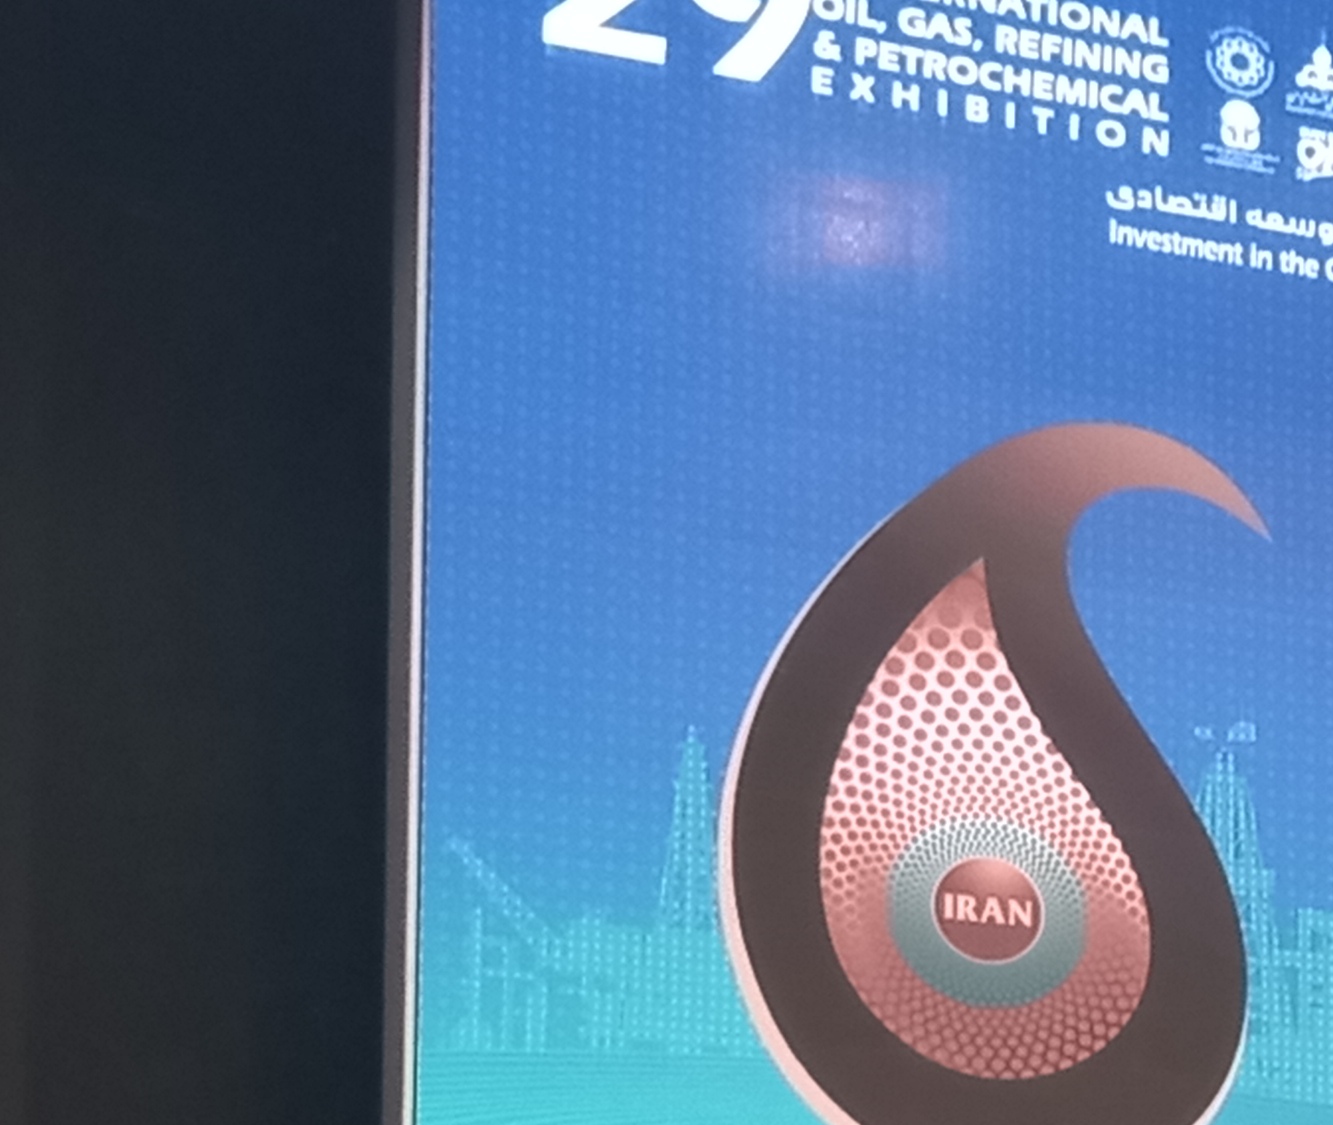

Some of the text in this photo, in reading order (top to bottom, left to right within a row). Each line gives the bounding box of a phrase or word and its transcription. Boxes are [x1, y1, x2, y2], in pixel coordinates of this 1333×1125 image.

[812, 0, 1169, 84] OIL, GAS, REFINING
[813, 30, 1169, 122] & PETROCHEMICAL
[811, 65, 1169, 157] EXHIBITION
[1105, 184, 1237, 224] اقتصادی
[1109, 218, 1243, 267] Investment
[1279, 250, 1319, 278] the
[944, 893, 1033, 927] IRAN
